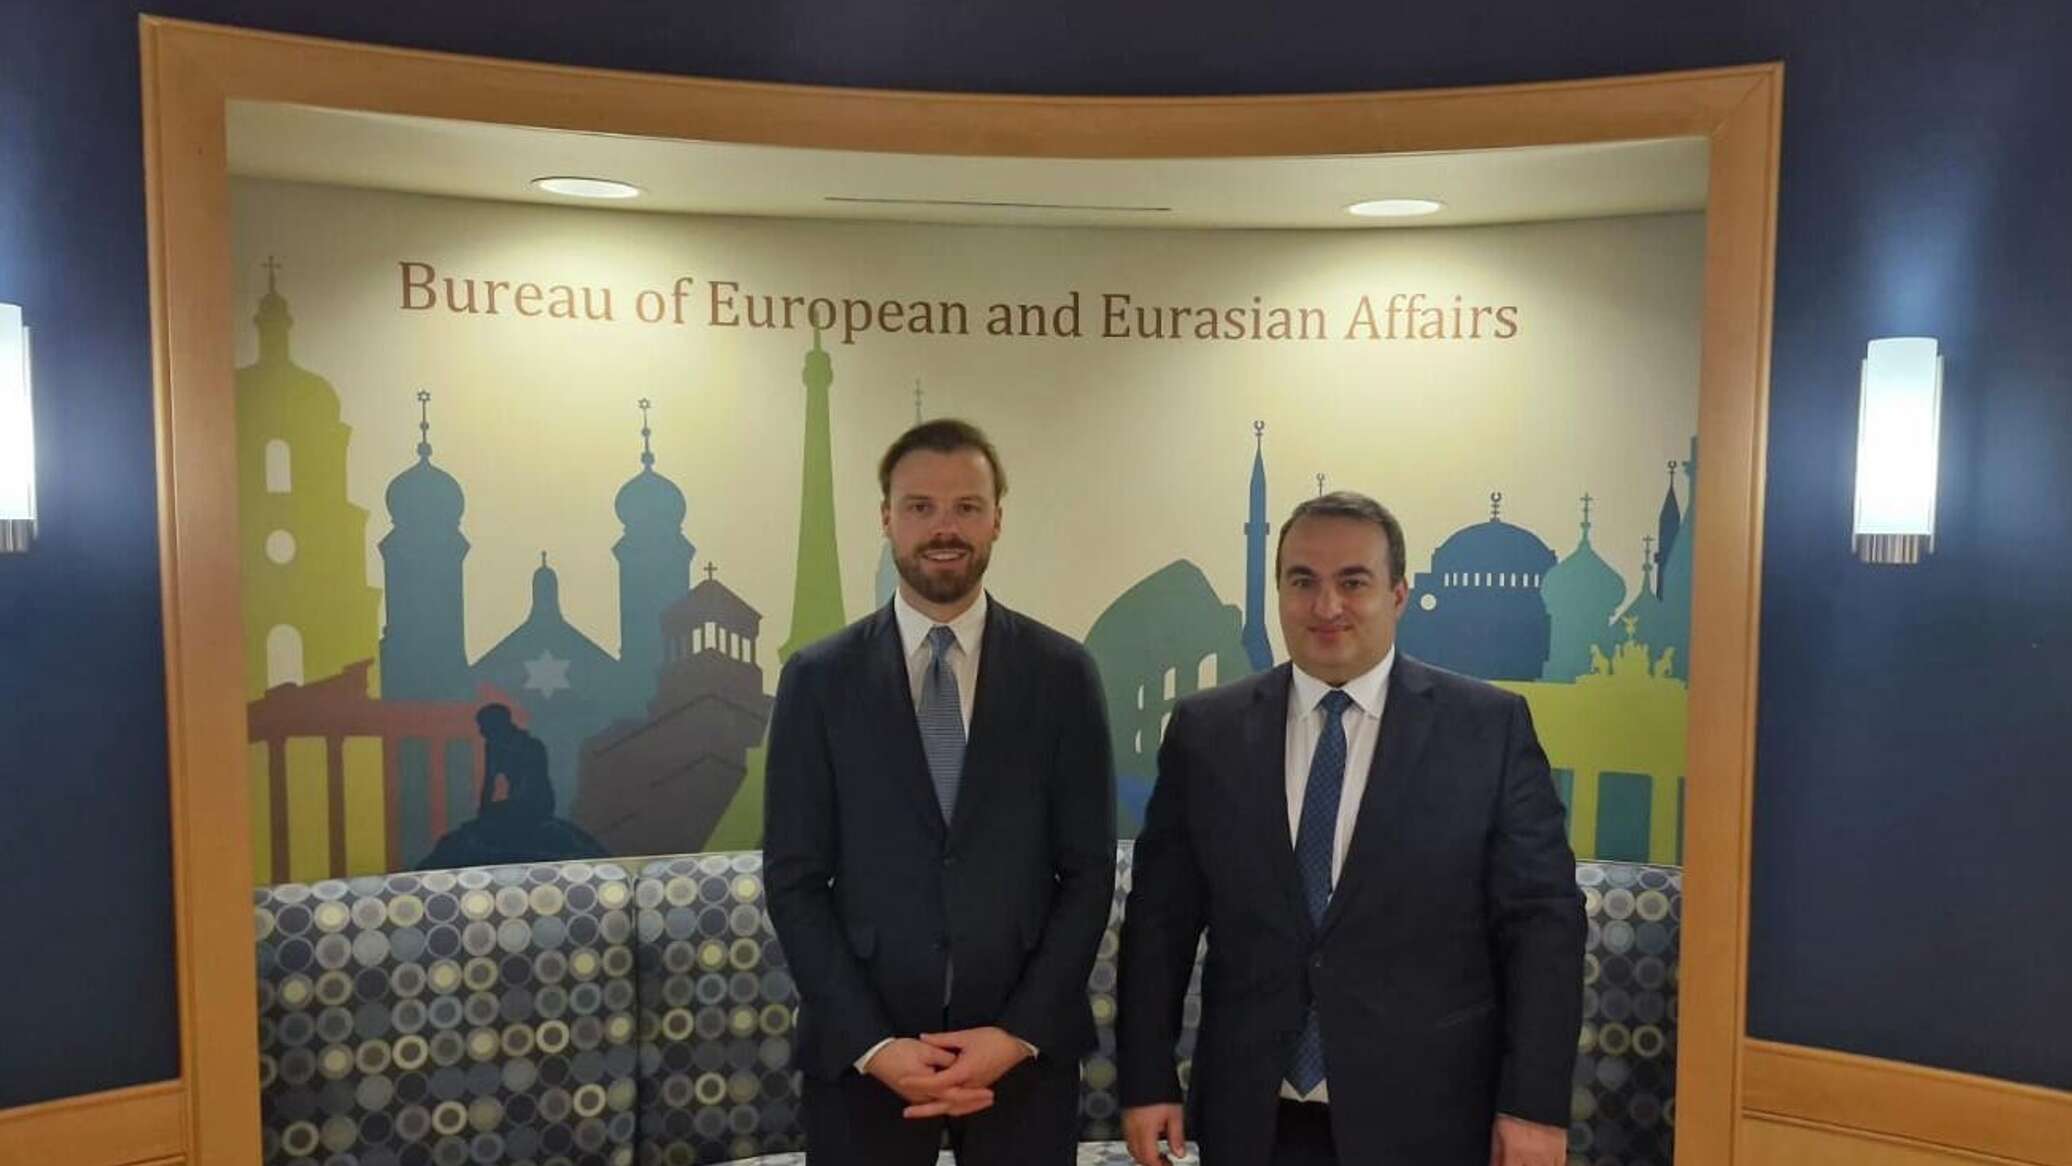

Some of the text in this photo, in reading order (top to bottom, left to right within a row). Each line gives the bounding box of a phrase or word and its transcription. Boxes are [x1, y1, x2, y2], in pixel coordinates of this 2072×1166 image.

[398, 261, 1519, 345] Bureau of European and Eurasian Affairs
